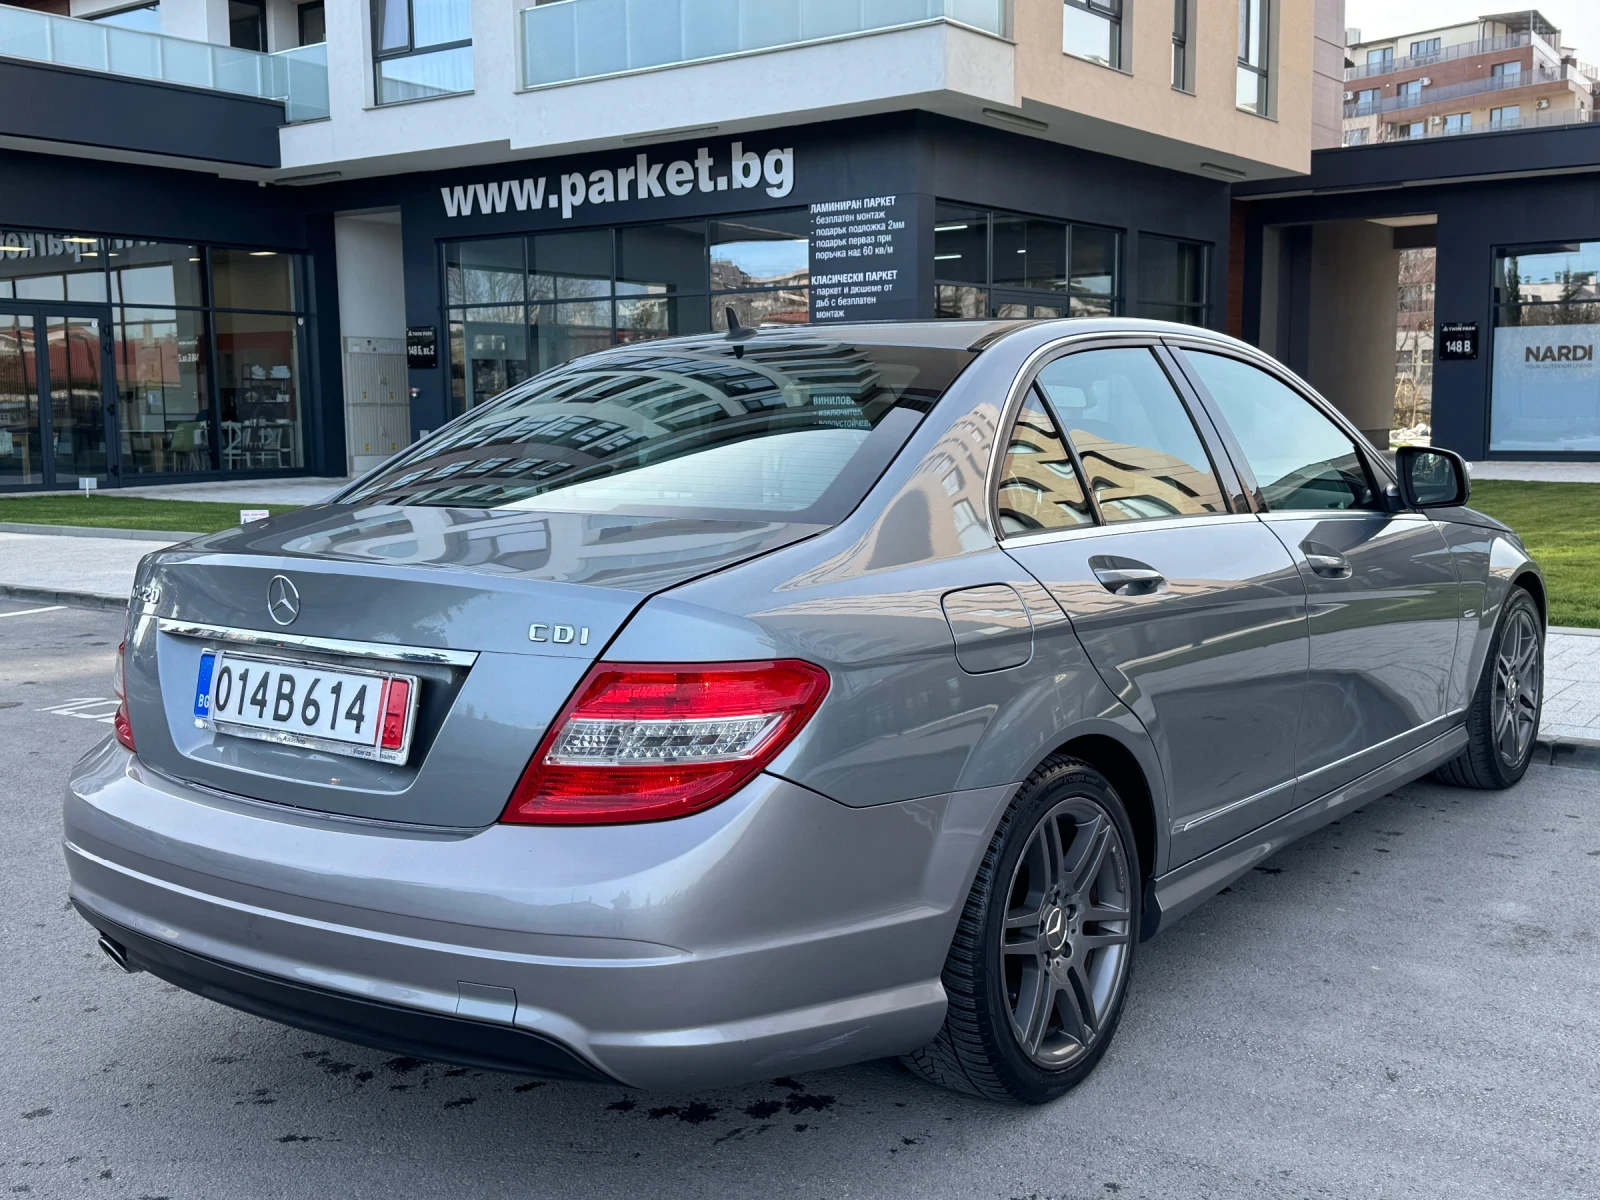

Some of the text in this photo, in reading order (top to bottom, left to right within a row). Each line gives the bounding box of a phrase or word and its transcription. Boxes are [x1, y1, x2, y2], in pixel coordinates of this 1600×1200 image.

[440, 141, 794, 219] www.parket.bg
[810, 196, 896, 214] ЛАМИНИРАН ПАРКЕТ
[815, 210, 886, 225] безплатен монтаж
[815, 219, 905, 237] подарък подложка 2мм
[815, 234, 892, 249] подарък перваз при
[815, 244, 893, 260] поръчка над 60 кв/м
[811, 270, 898, 285] КЛАСИЧЕСКИ ПАРКЕТ
[816, 283, 893, 297] паркет и дюшеме от
[815, 298, 830, 308] дъб
[837, 296, 877, 306] безплатен
[816, 309, 845, 319] монтаж
[1445, 340, 1463, 352] 148
[1525, 344, 1593, 362] NARDI
[528, 624, 589, 646] CDI
[215, 665, 367, 734] 014B614
